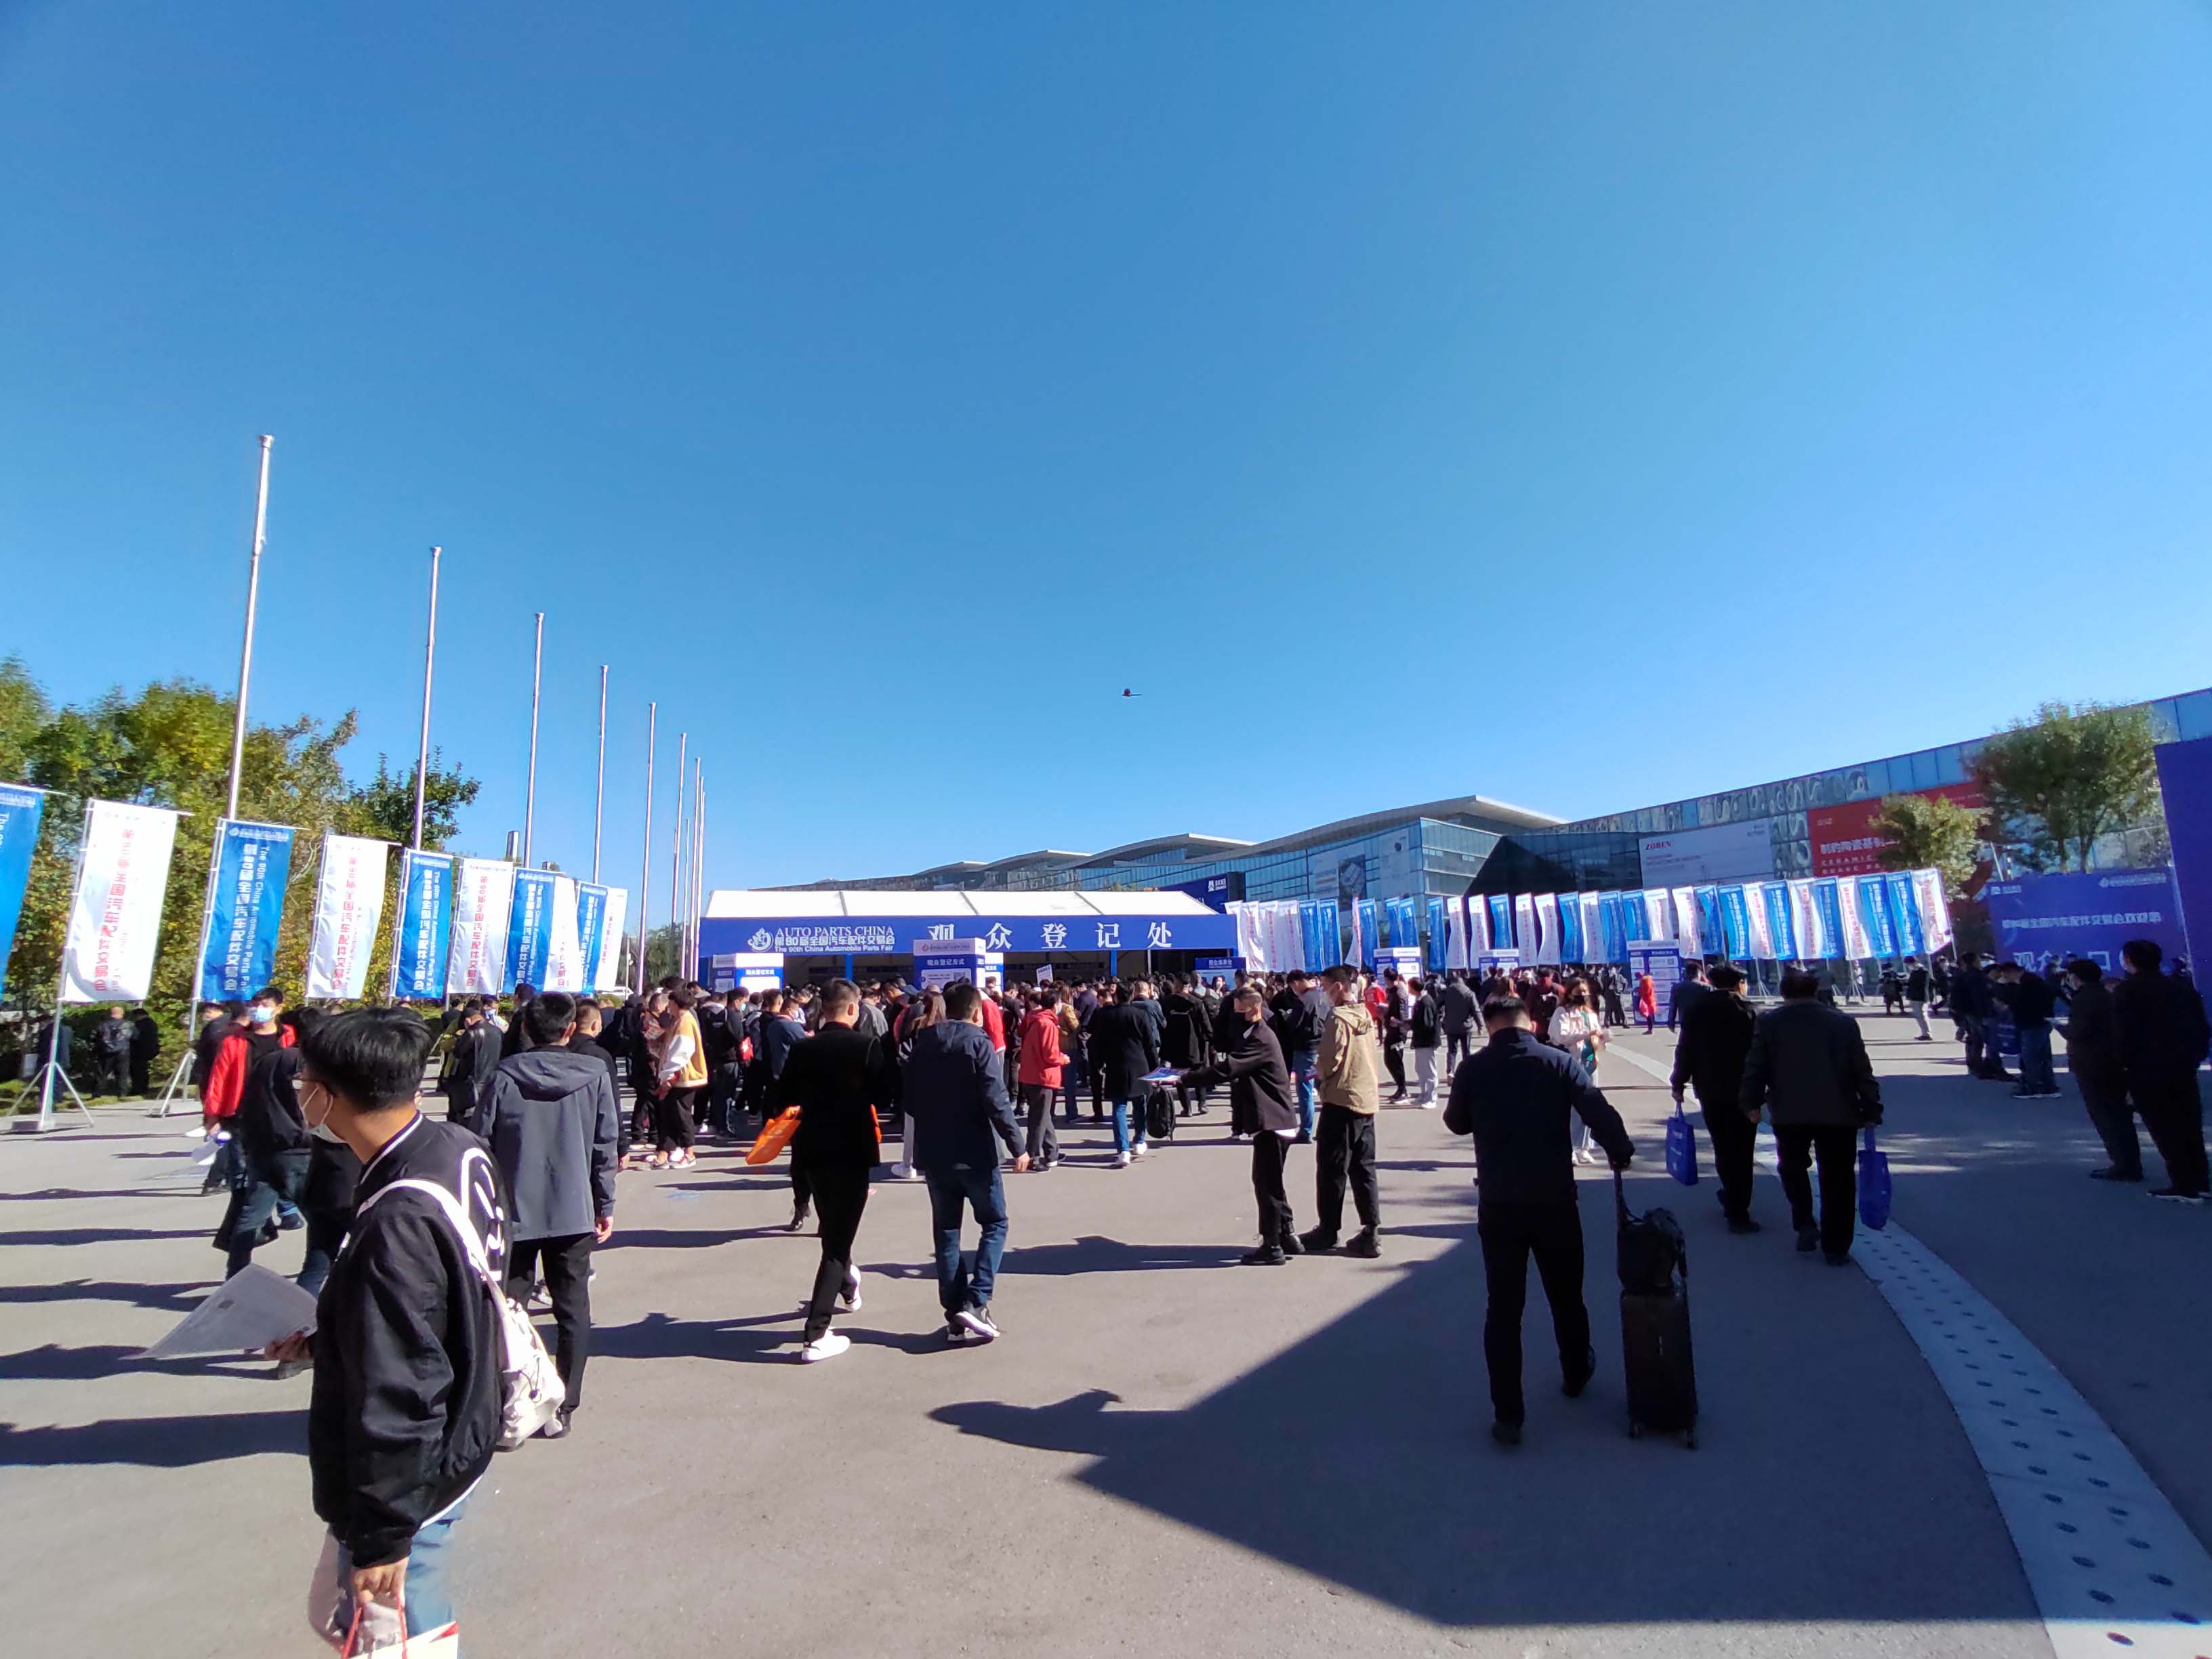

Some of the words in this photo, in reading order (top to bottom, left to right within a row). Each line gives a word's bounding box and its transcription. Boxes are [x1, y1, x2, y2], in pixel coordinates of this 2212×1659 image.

[252, 882, 264, 904] China
[776, 927, 811, 937] AUTO
[815, 926, 852, 937] PARTS
[855, 926, 895, 936] CHINA
[928, 922, 1172, 949] 观众登记处
